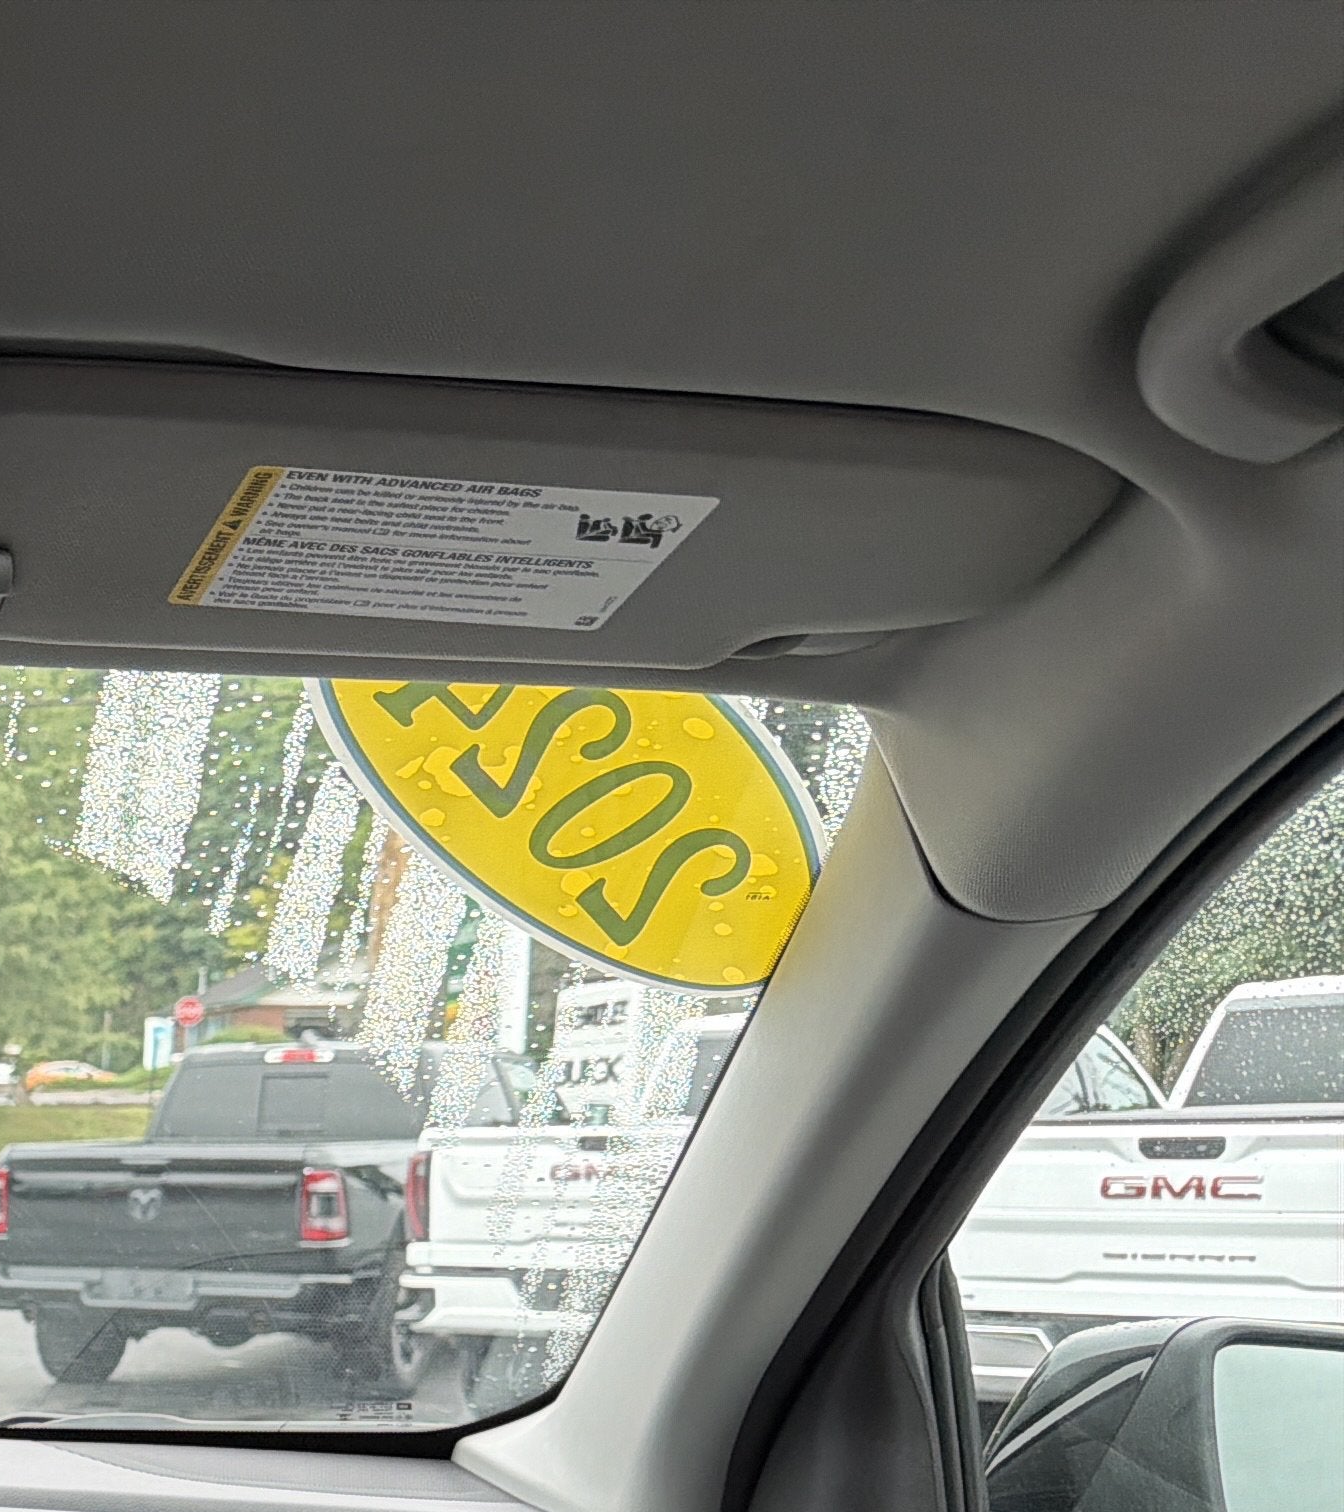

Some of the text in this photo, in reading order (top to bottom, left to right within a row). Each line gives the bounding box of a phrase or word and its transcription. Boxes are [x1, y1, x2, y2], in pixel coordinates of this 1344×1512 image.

[232, 470, 273, 519] WARNING
[286, 471, 543, 497] EVEN WITH ADVANCED AIR BAGS
[242, 536, 594, 570] MÊME AVEC DES SACS GONFLABLES INTELLIGENTS
[1099, 1174, 1265, 1202] GMC
